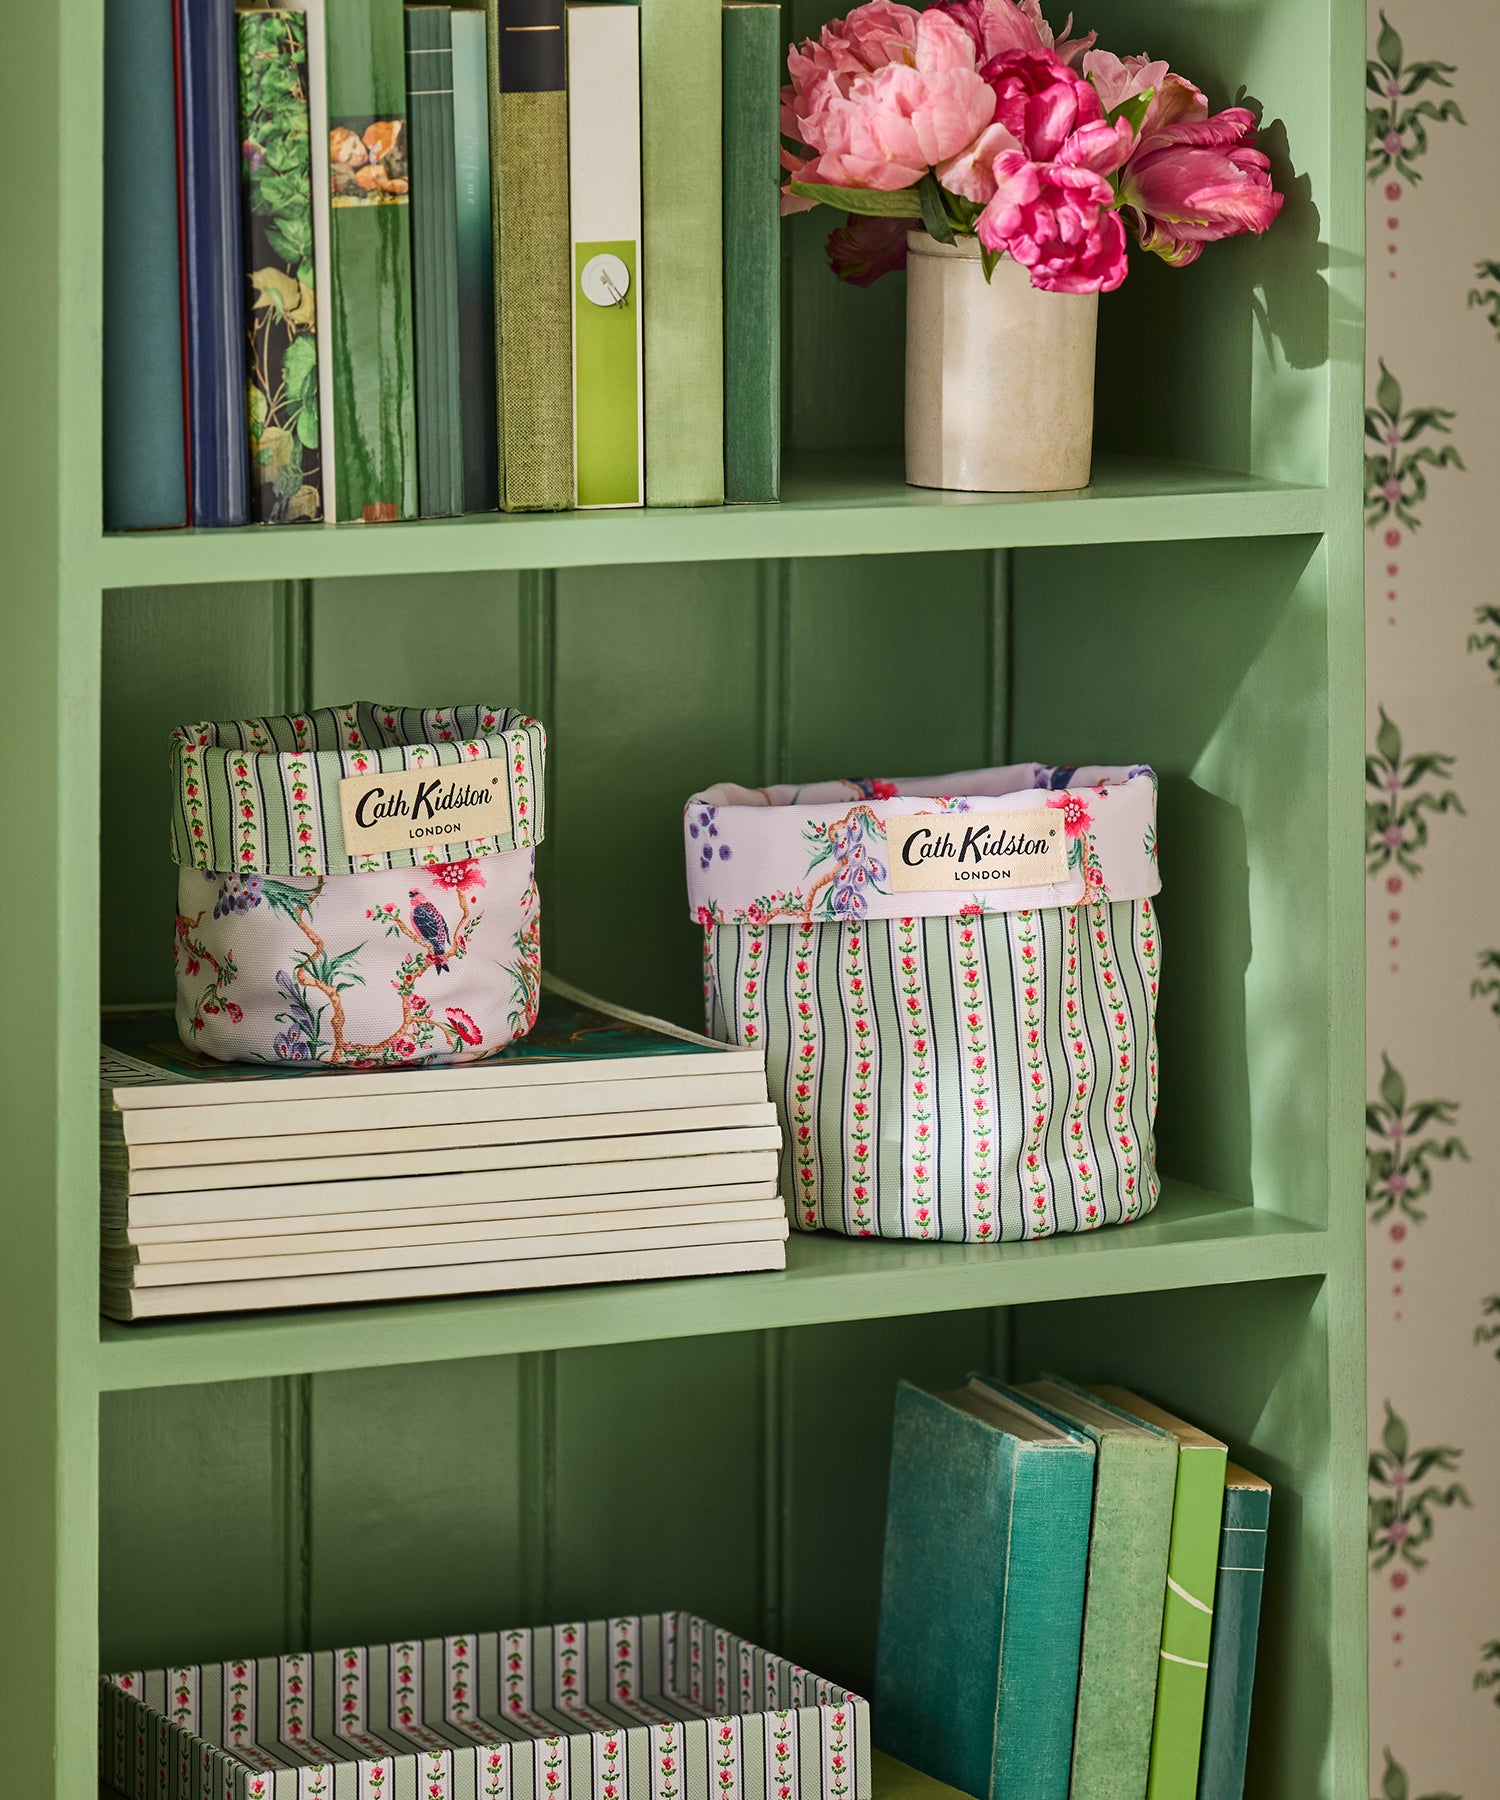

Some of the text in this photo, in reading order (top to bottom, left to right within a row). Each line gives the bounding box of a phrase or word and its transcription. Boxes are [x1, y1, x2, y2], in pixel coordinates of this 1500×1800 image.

[355, 787, 409, 828] Cath
[409, 823, 461, 839] LONDON
[902, 828, 956, 866] Cath
[954, 870, 1011, 881] LONDON
